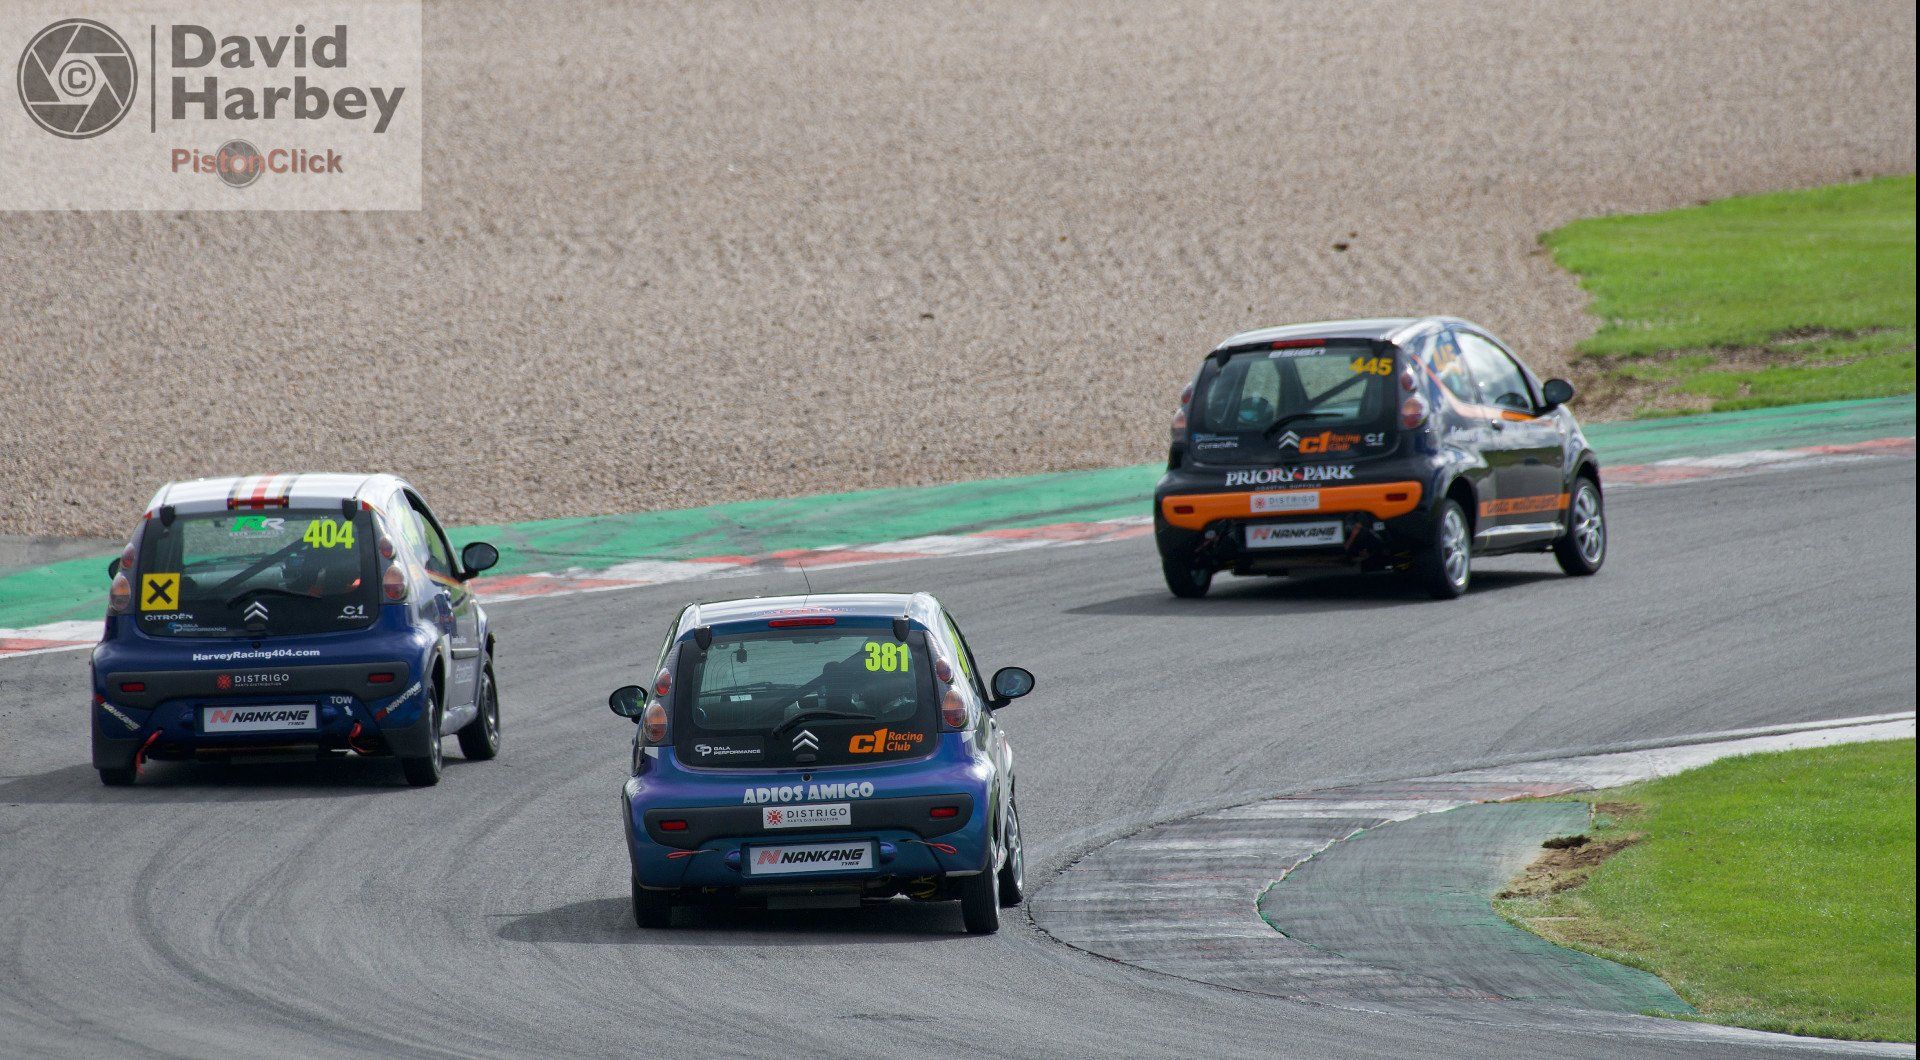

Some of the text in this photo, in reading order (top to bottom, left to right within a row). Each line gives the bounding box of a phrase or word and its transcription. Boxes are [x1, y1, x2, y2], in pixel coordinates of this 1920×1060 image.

[1348, 356, 1393, 376] 445
[1224, 464, 1355, 487] PRIORY PARK
[303, 519, 355, 549] 404
[342, 604, 364, 615] C1
[192, 649, 320, 661] HarveyRacing404.com
[864, 642, 909, 672] 381
[234, 673, 290, 683] DISTRIGO
[330, 696, 353, 704] TOW
[232, 710, 310, 723] NANKANG
[888, 731, 924, 743] Racing
[886, 741, 911, 751] Club
[743, 781, 875, 804] ADIOS AMIGO
[787, 808, 847, 819] DISTRIGO
[780, 848, 865, 864] NANKANG
